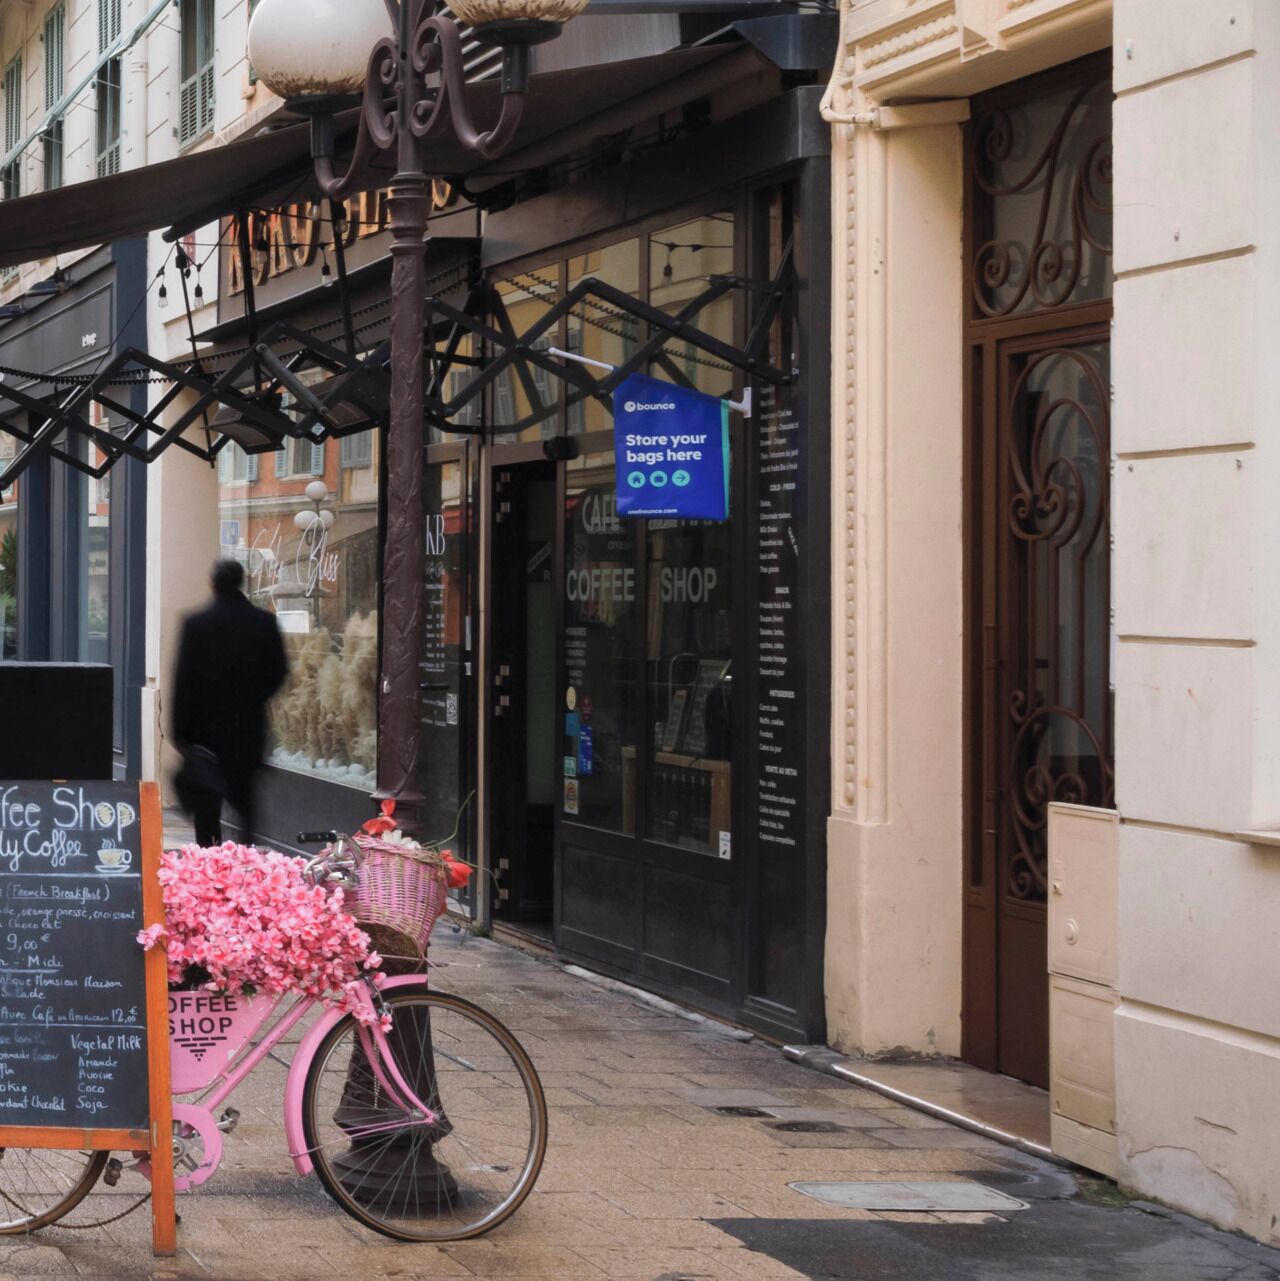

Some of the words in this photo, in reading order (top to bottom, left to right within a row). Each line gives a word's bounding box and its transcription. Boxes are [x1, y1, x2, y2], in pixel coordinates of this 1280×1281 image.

[637, 402, 676, 411] bounce
[626, 434, 668, 446] Store
[670, 434, 707, 448] your
[626, 451, 664, 465] bags
[666, 449, 702, 461] here
[566, 568, 635, 601] COFFEE
[660, 567, 717, 603] SHOP
[52, 786, 135, 842] Shop
[24, 829, 88, 868] Coffee
[27, 954, 64, 968] Midi
[71, 1033, 115, 1055] Vegetal
[117, 1035, 141, 1050] Milk
[77, 1082, 105, 1093] Coco
[75, 1096, 109, 1113] Soja
